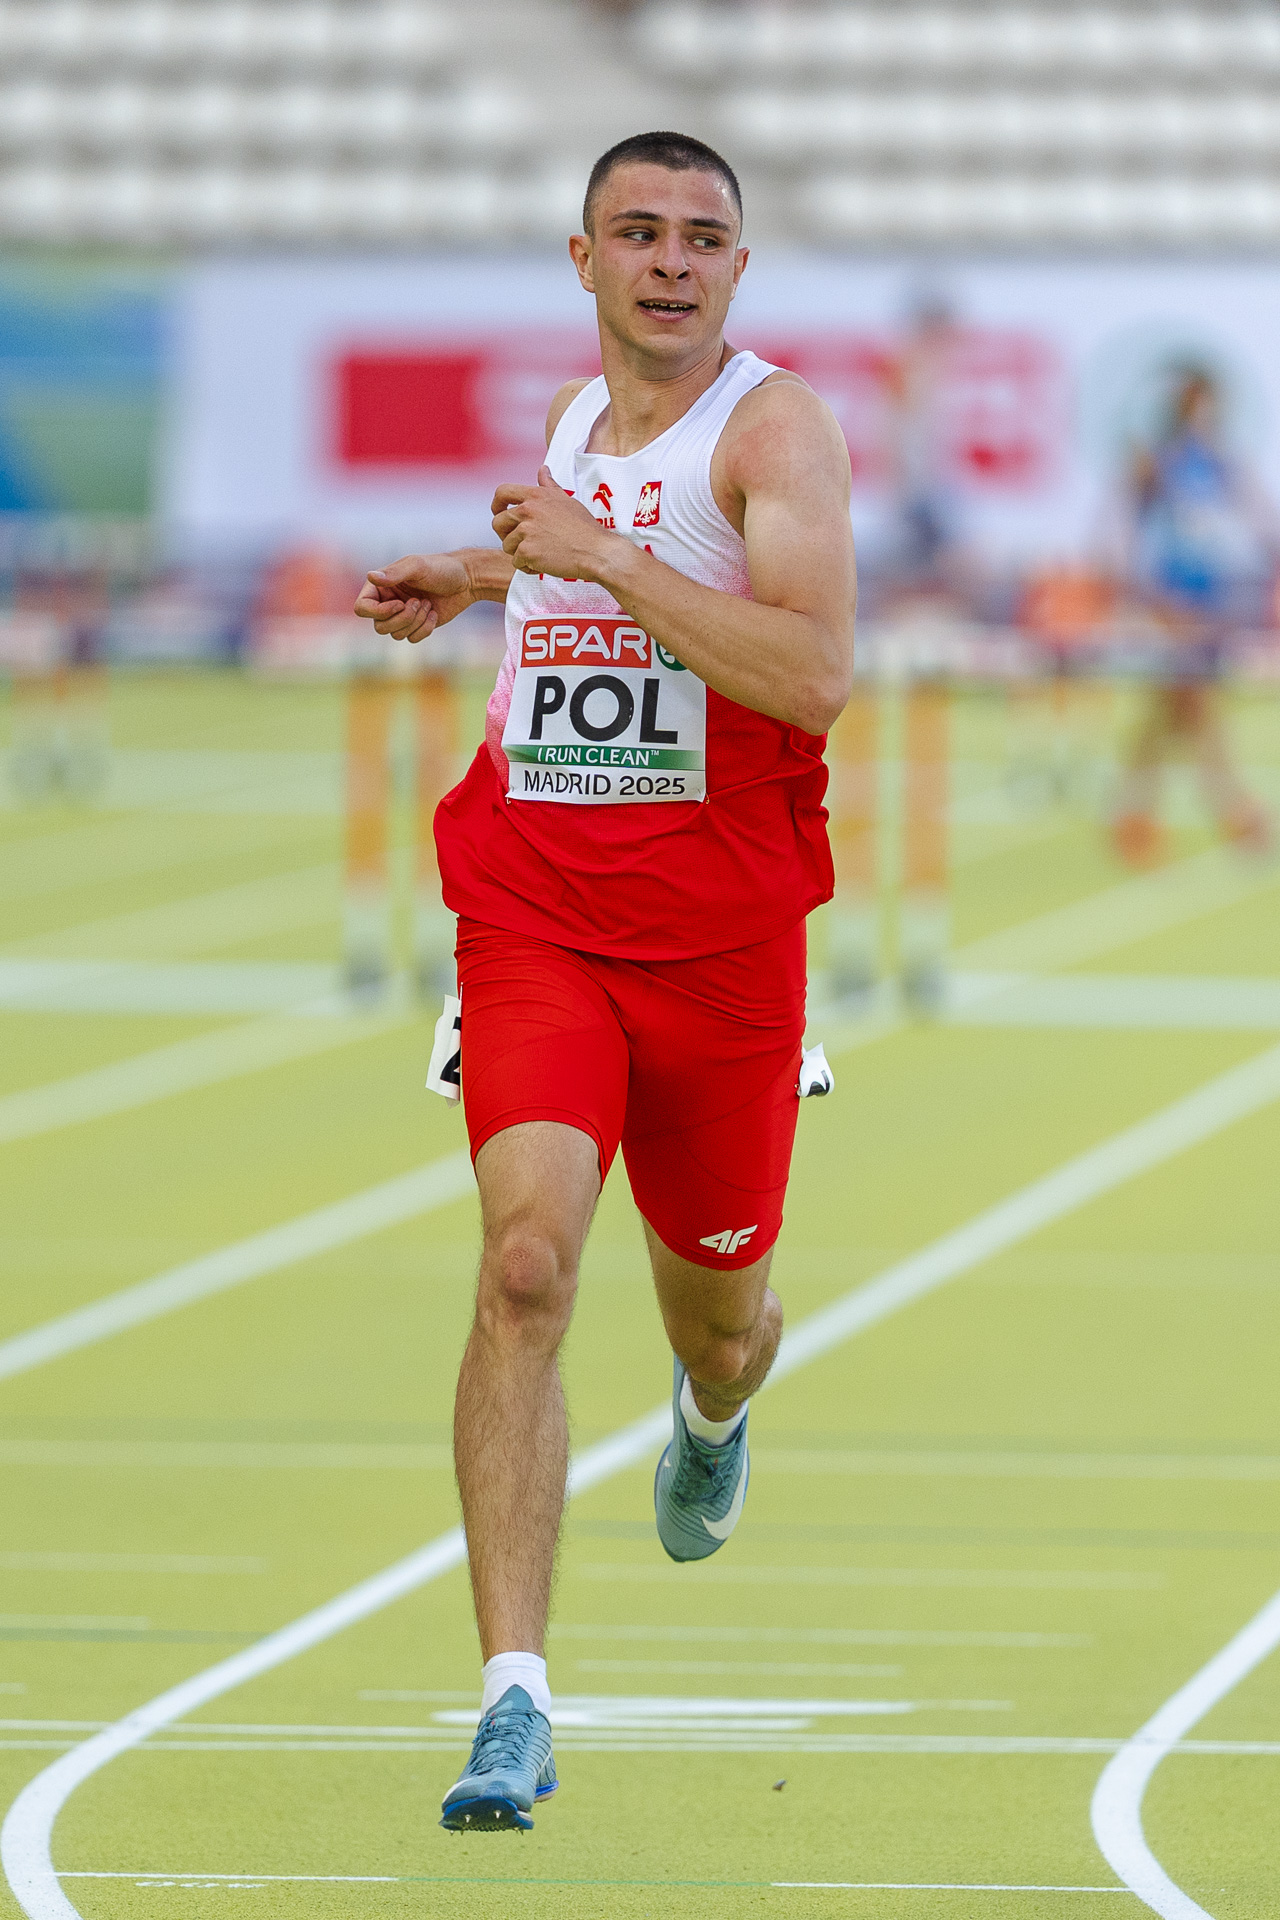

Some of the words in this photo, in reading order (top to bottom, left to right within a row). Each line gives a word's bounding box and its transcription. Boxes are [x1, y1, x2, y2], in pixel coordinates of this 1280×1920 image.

[525, 626, 648, 661] SPAR
[528, 674, 678, 744] POL
[545, 747, 580, 763] RUN
[524, 770, 611, 795] MADRID
[619, 775, 686, 796] 2025
